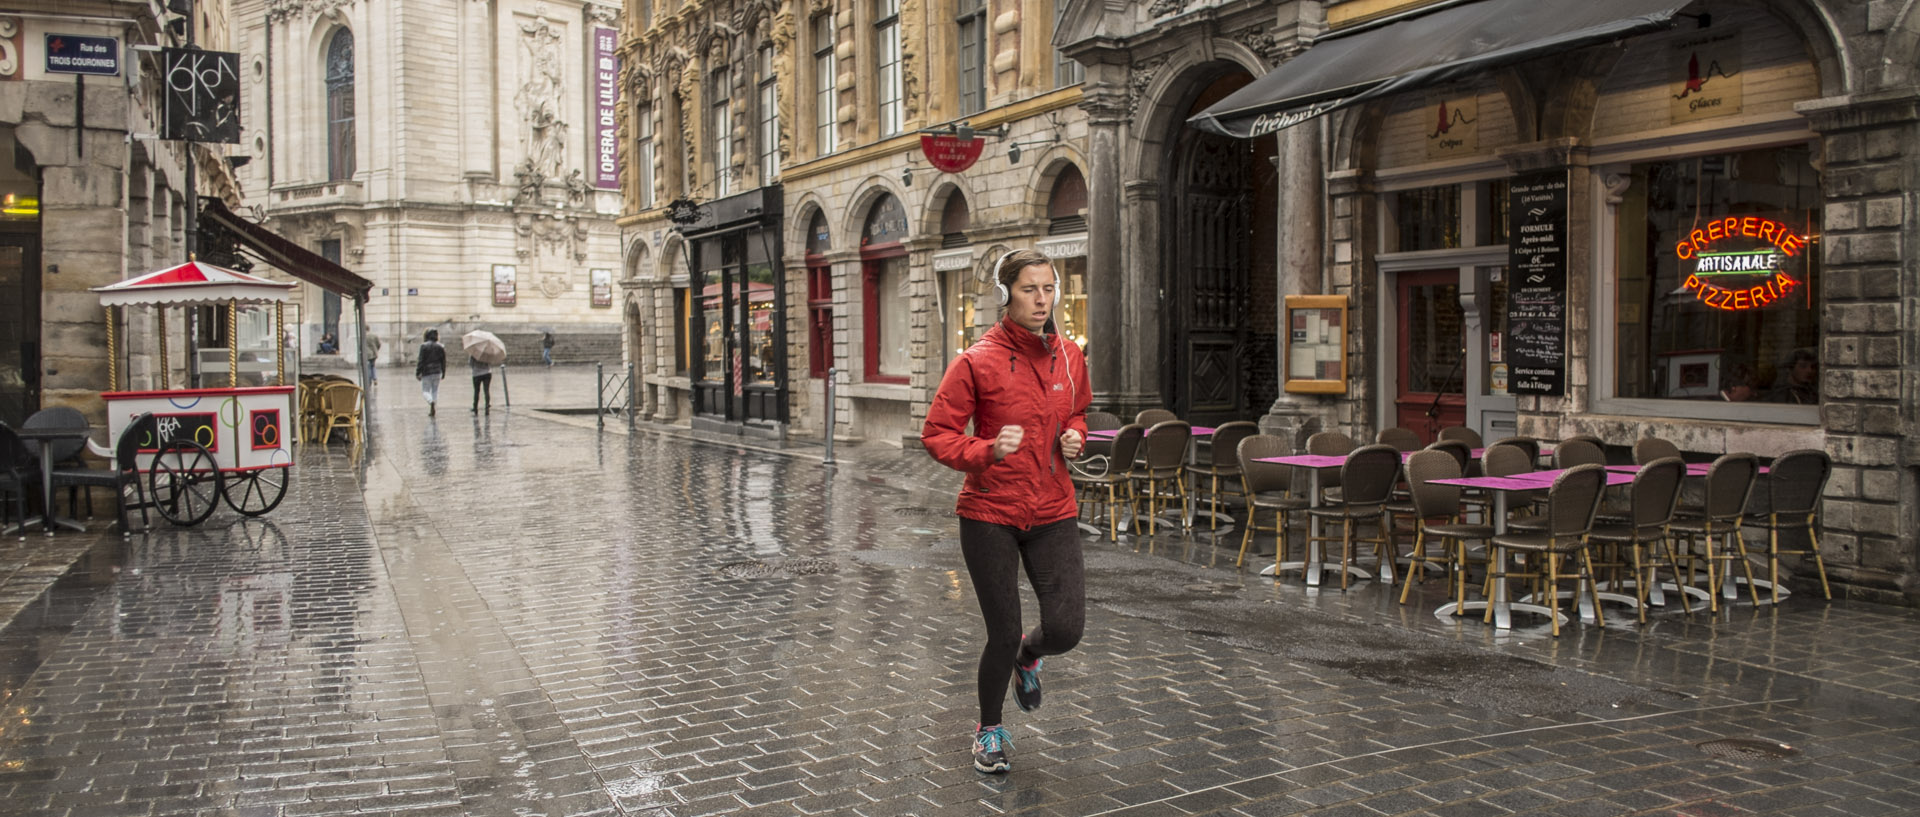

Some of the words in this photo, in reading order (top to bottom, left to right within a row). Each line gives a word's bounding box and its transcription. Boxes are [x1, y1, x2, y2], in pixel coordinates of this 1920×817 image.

[80, 43, 93, 52] Rue
[94, 44, 107, 53] des
[49, 56, 71, 65] TROIS
[71, 57, 115, 68] COURONNES
[600, 71, 614, 106] LILLE
[1689, 97, 1722, 113] Glaces
[601, 108, 614, 126] DE
[601, 128, 615, 173] OPERA
[1439, 139, 1463, 149] Crêpes
[1520, 224, 1554, 233] FORMULE
[1044, 243, 1081, 257] BIJOUX
[1697, 254, 1779, 271] ARTISANALE
[1683, 274, 1799, 311] PIZZERIA
[1515, 367, 1534, 375] Service
[1534, 368, 1555, 376] continu
[1517, 381, 1530, 389] Salle
[1534, 381, 1552, 392] l'étage
